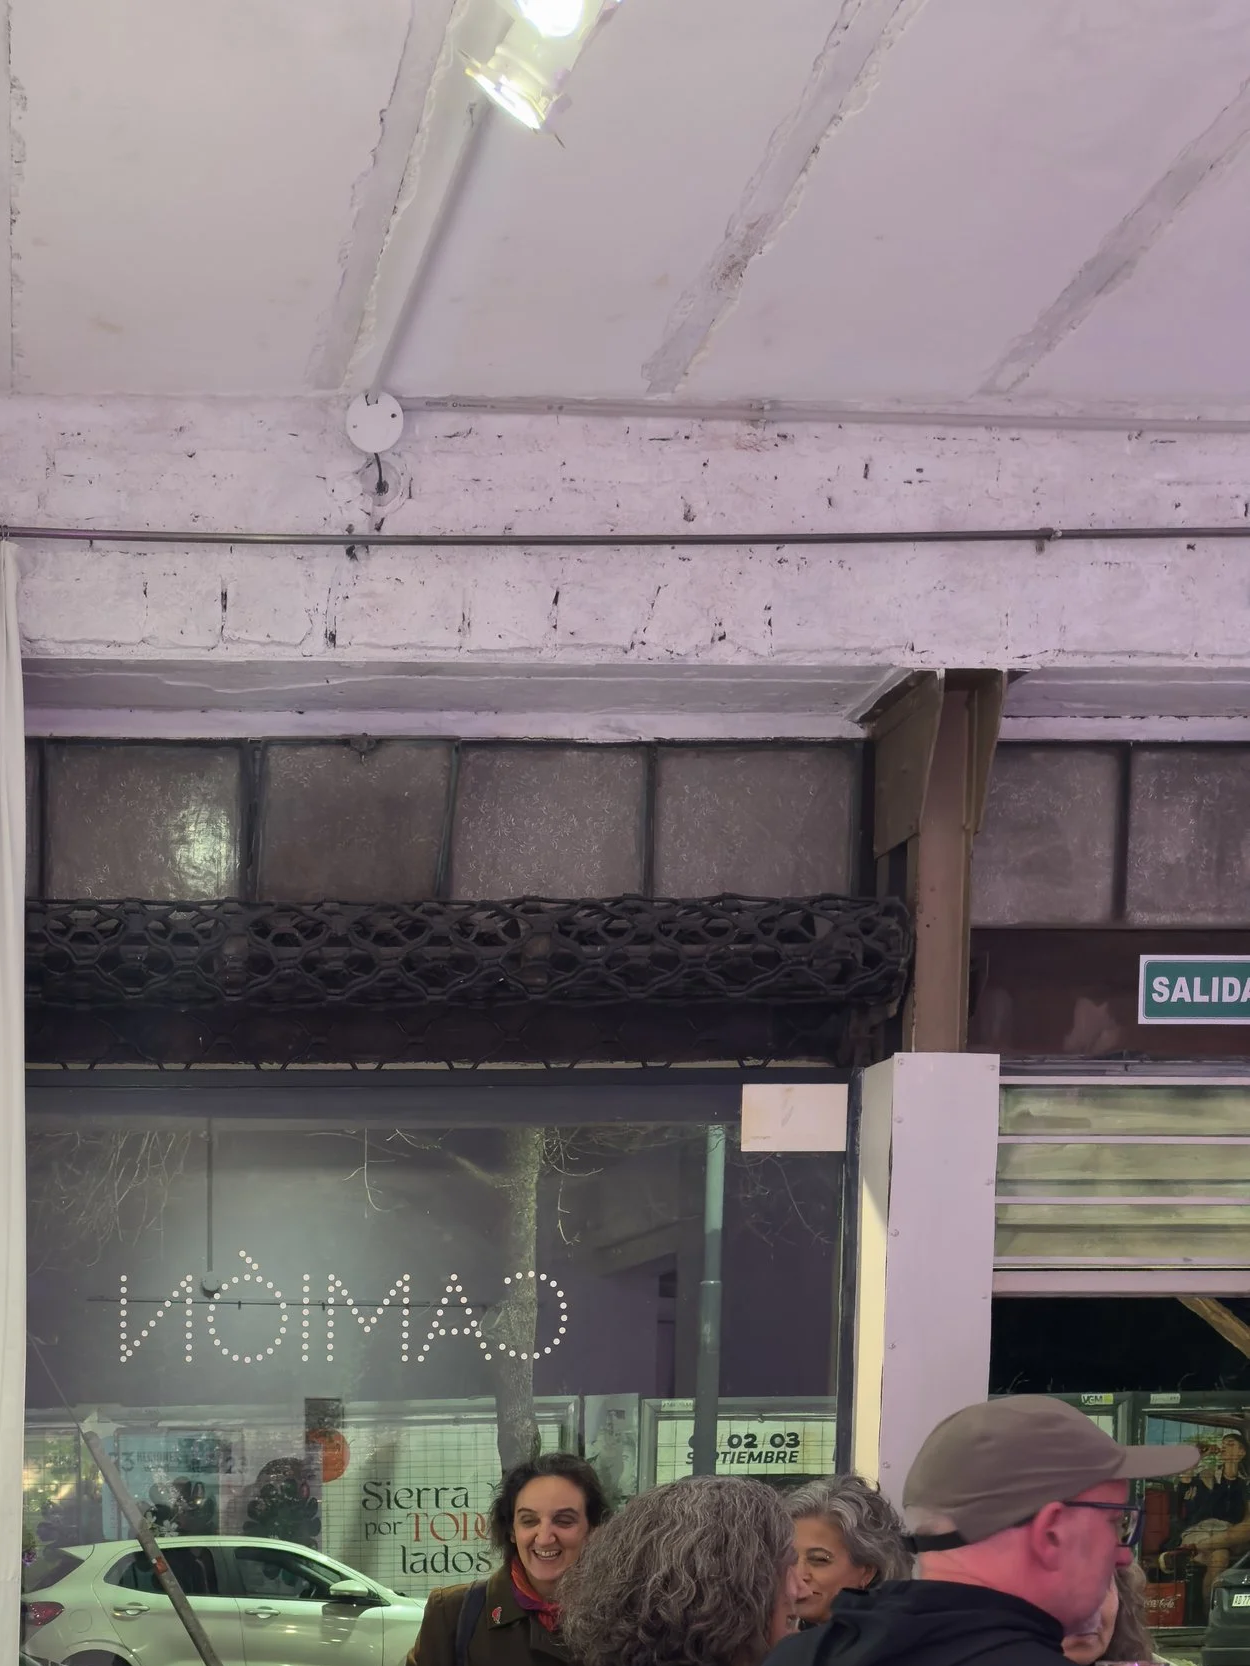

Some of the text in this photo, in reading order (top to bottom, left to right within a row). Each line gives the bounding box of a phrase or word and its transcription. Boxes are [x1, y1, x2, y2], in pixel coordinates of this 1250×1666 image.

[727, 1432, 800, 1449] 02 03
[686, 1450, 800, 1465] STIEMBRE
[361, 1481, 470, 1510] Sierra
[365, 1511, 492, 1543] por TOD
[400, 1544, 493, 1574] lados
